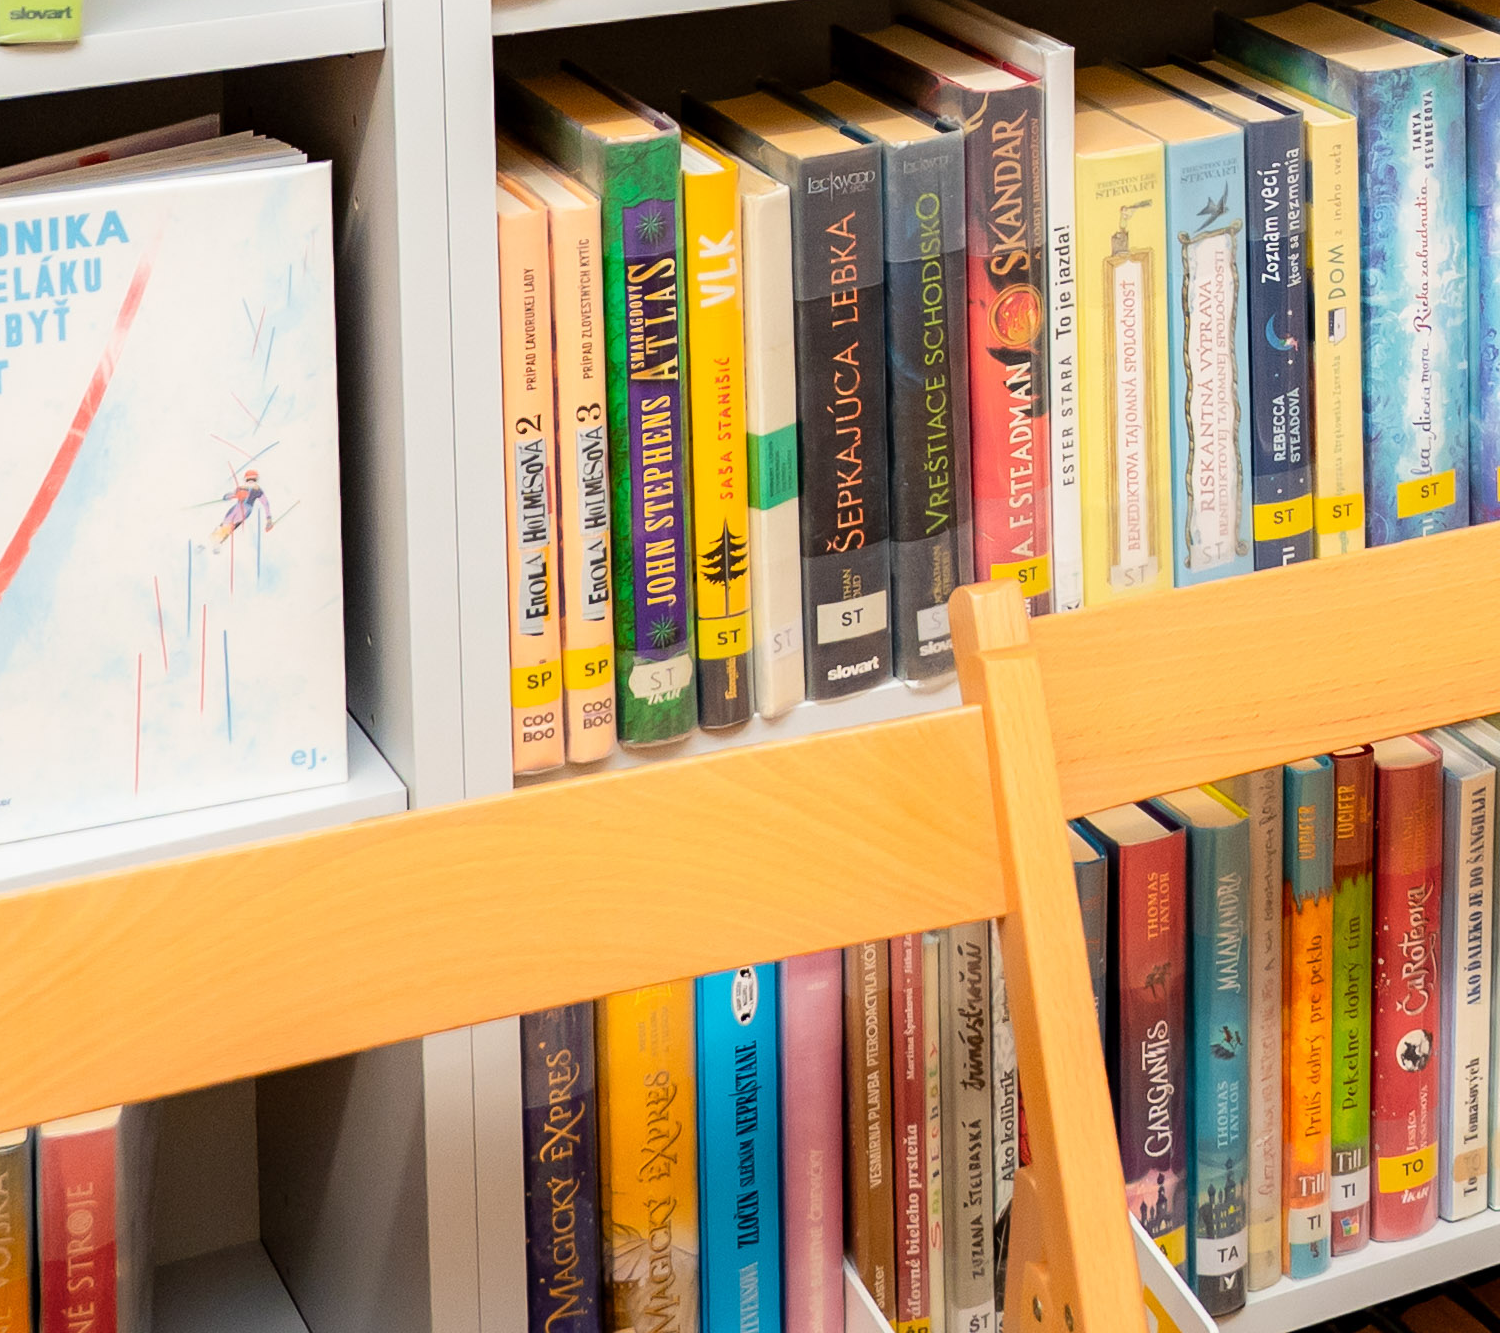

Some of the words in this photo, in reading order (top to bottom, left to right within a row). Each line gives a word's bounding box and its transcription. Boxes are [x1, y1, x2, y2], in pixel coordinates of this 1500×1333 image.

[9, 5, 73, 23] slovart
[992, 110, 1028, 275] SKANDAR
[1258, 161, 1282, 212] vecí,
[700, 230, 736, 309] VLK
[830, 211, 858, 331] LEBKA
[917, 192, 945, 365] SCHODISKO
[1056, 224, 1074, 282] jazda!
[1262, 216, 1282, 284] Zoznam
[1056, 283, 1073, 312] je
[1056, 317, 1071, 341] To
[1059, 355, 1073, 425] STARÁ
[1291, 386, 1300, 464] STEADOVÁ
[642, 395, 673, 528] STEPHENS
[830, 342, 866, 555] ŠEPKAJÚCA
[1006, 361, 1034, 511] STEADMAN
[1061, 427, 1075, 486] ESTER
[1273, 395, 1286, 462] REBECCA
[647, 529, 676, 608] JOHN
